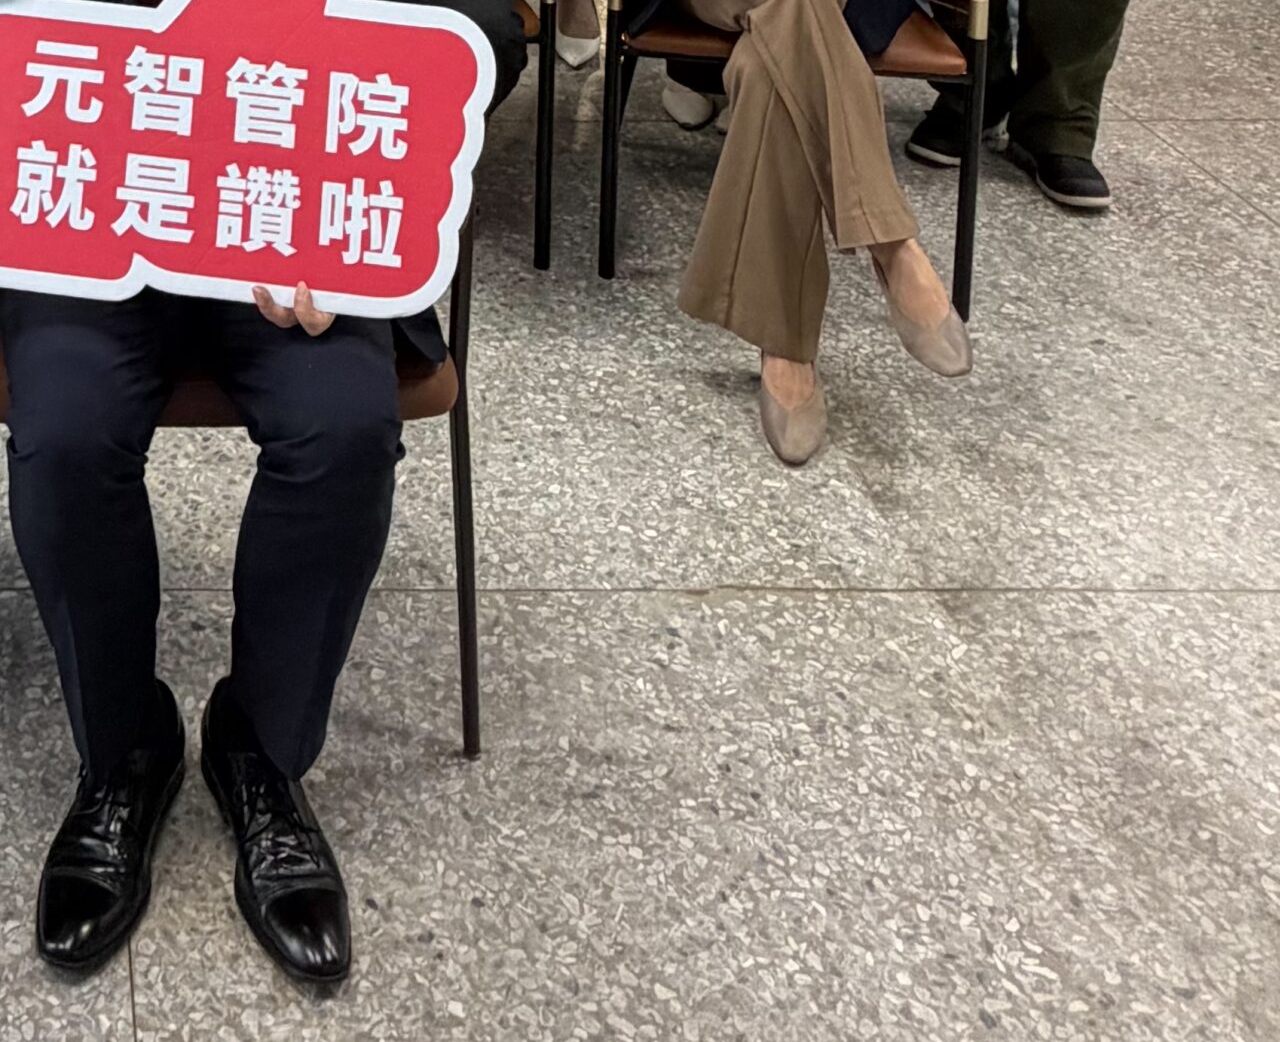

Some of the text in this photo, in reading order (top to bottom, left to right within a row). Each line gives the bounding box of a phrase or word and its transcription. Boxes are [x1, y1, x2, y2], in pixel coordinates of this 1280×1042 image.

[21, 39, 410, 160] 元智管院
[10, 139, 404, 268] 就是讚啦
